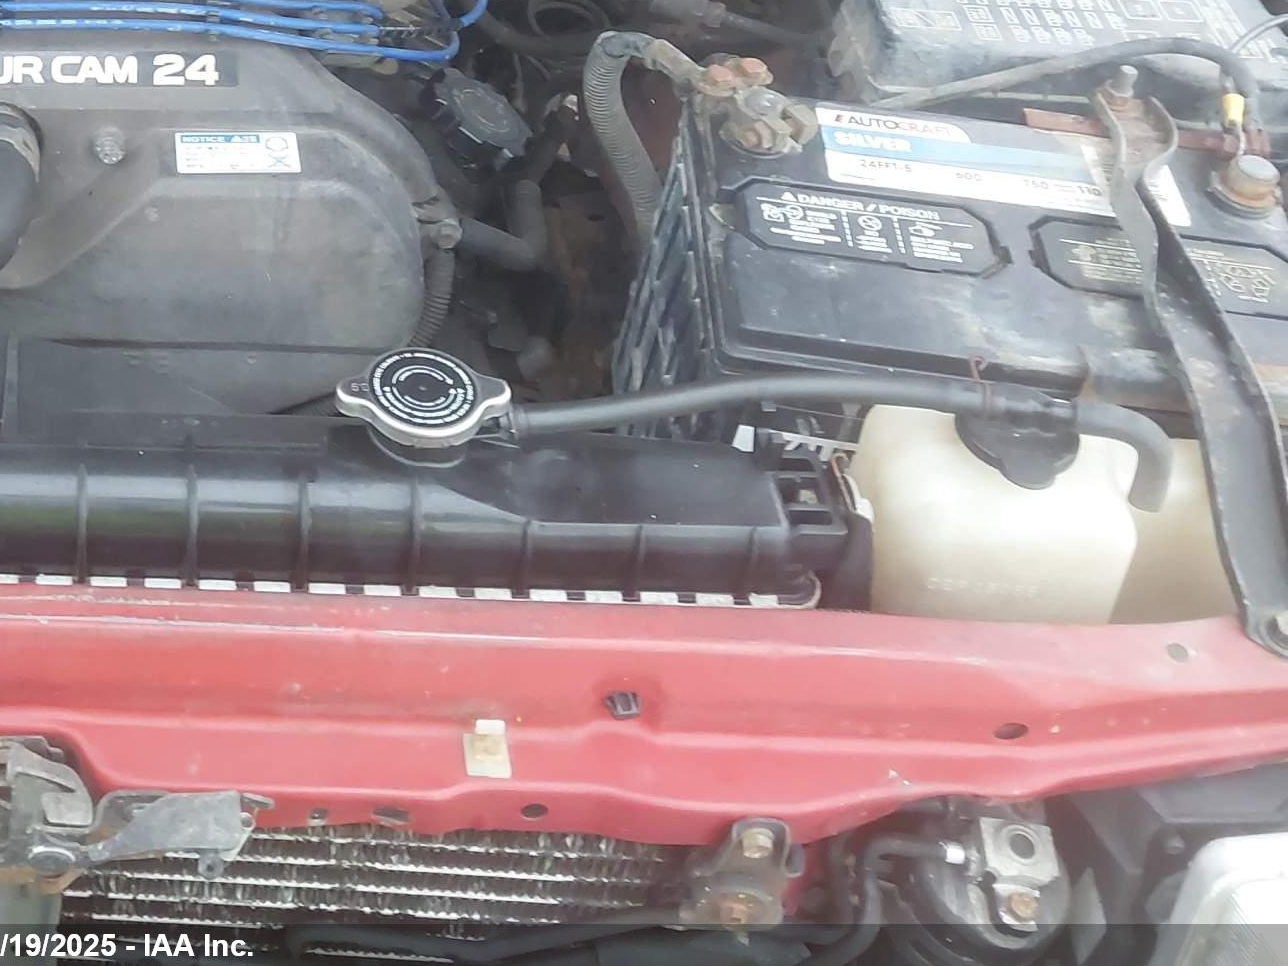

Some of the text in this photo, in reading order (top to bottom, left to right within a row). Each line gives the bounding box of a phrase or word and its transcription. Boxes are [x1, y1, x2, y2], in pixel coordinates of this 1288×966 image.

[50, 54, 138, 84] CAM
[151, 53, 220, 86] 24
[847, 115, 952, 136] AUTOCRAFT
[833, 130, 912, 153] SILVER
[796, 192, 865, 212] DANGER
[879, 204, 941, 221] POISON
